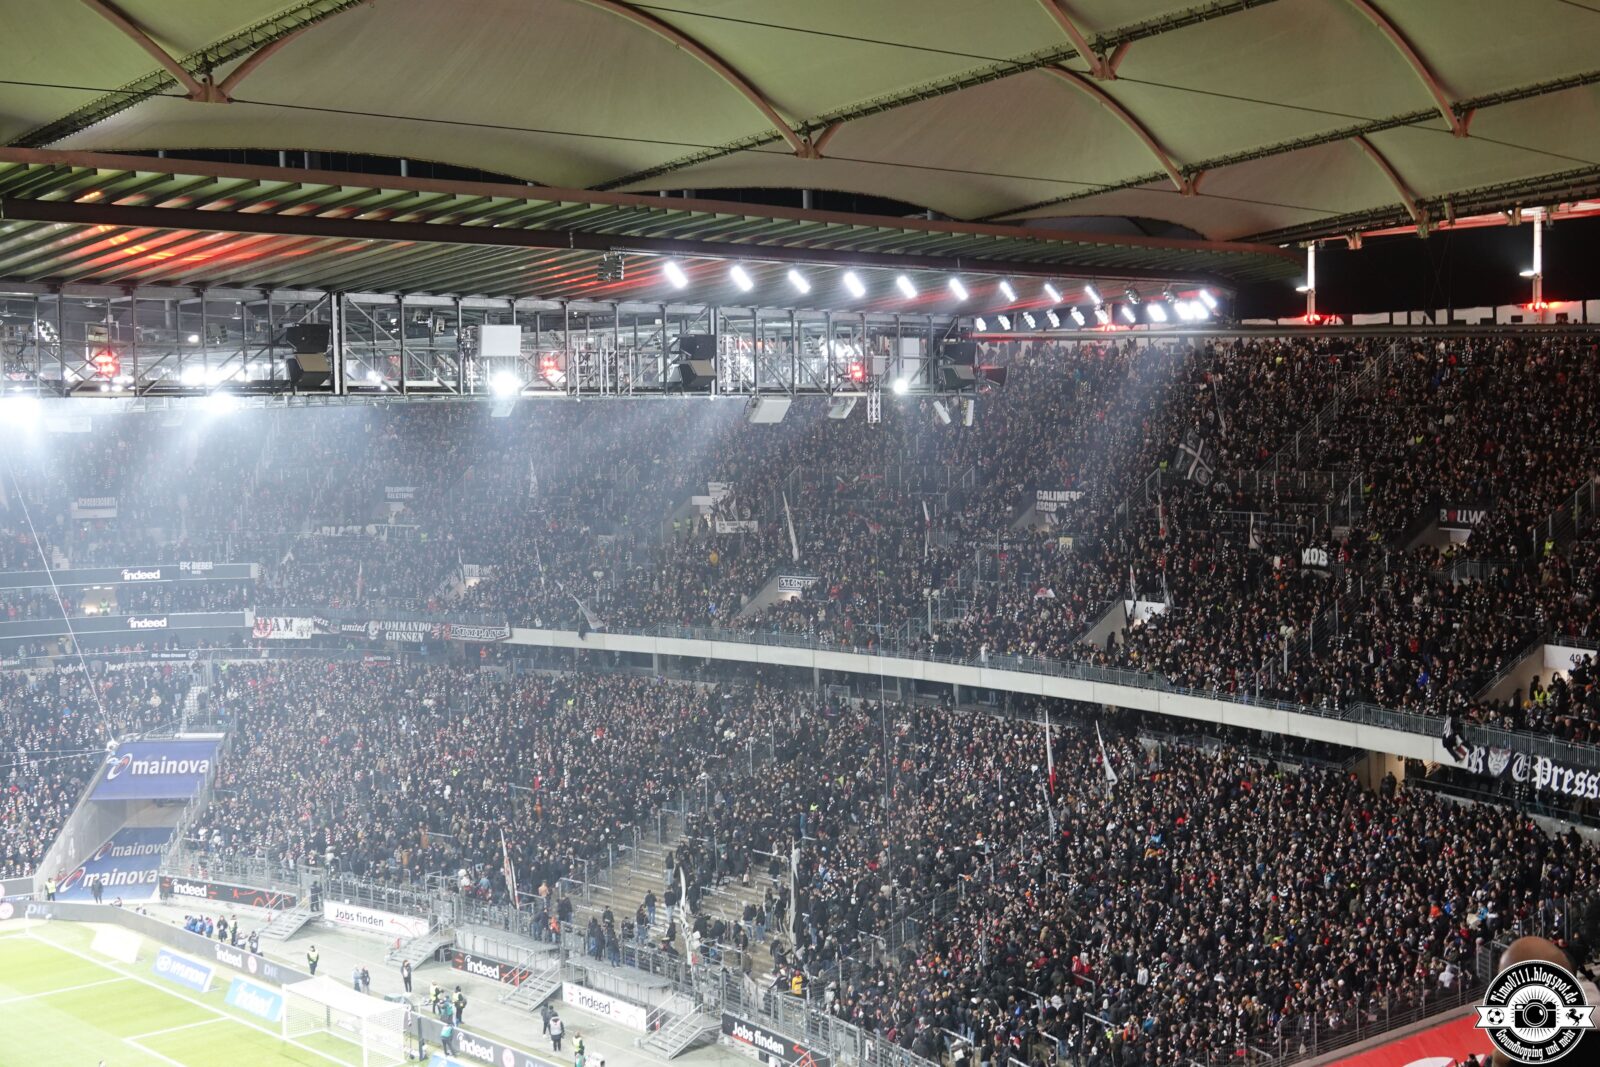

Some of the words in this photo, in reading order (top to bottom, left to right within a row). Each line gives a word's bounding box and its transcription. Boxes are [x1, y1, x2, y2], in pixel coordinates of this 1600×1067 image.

[121, 568, 160, 580] indeed
[127, 616, 167, 628] indeed
[380, 621, 431, 632] COMMANDO
[131, 756, 210, 775] mainova
[1532, 754, 1600, 800] Press
[82, 867, 159, 888] mainova
[171, 879, 207, 897] indeed
[335, 908, 354, 921] Jobs
[356, 912, 384, 927] finden
[465, 954, 500, 979] indeed
[578, 991, 611, 1015] indeed
[456, 1031, 495, 1063] indeed
[732, 1021, 754, 1042] Jobs
[754, 1030, 785, 1056] finden
